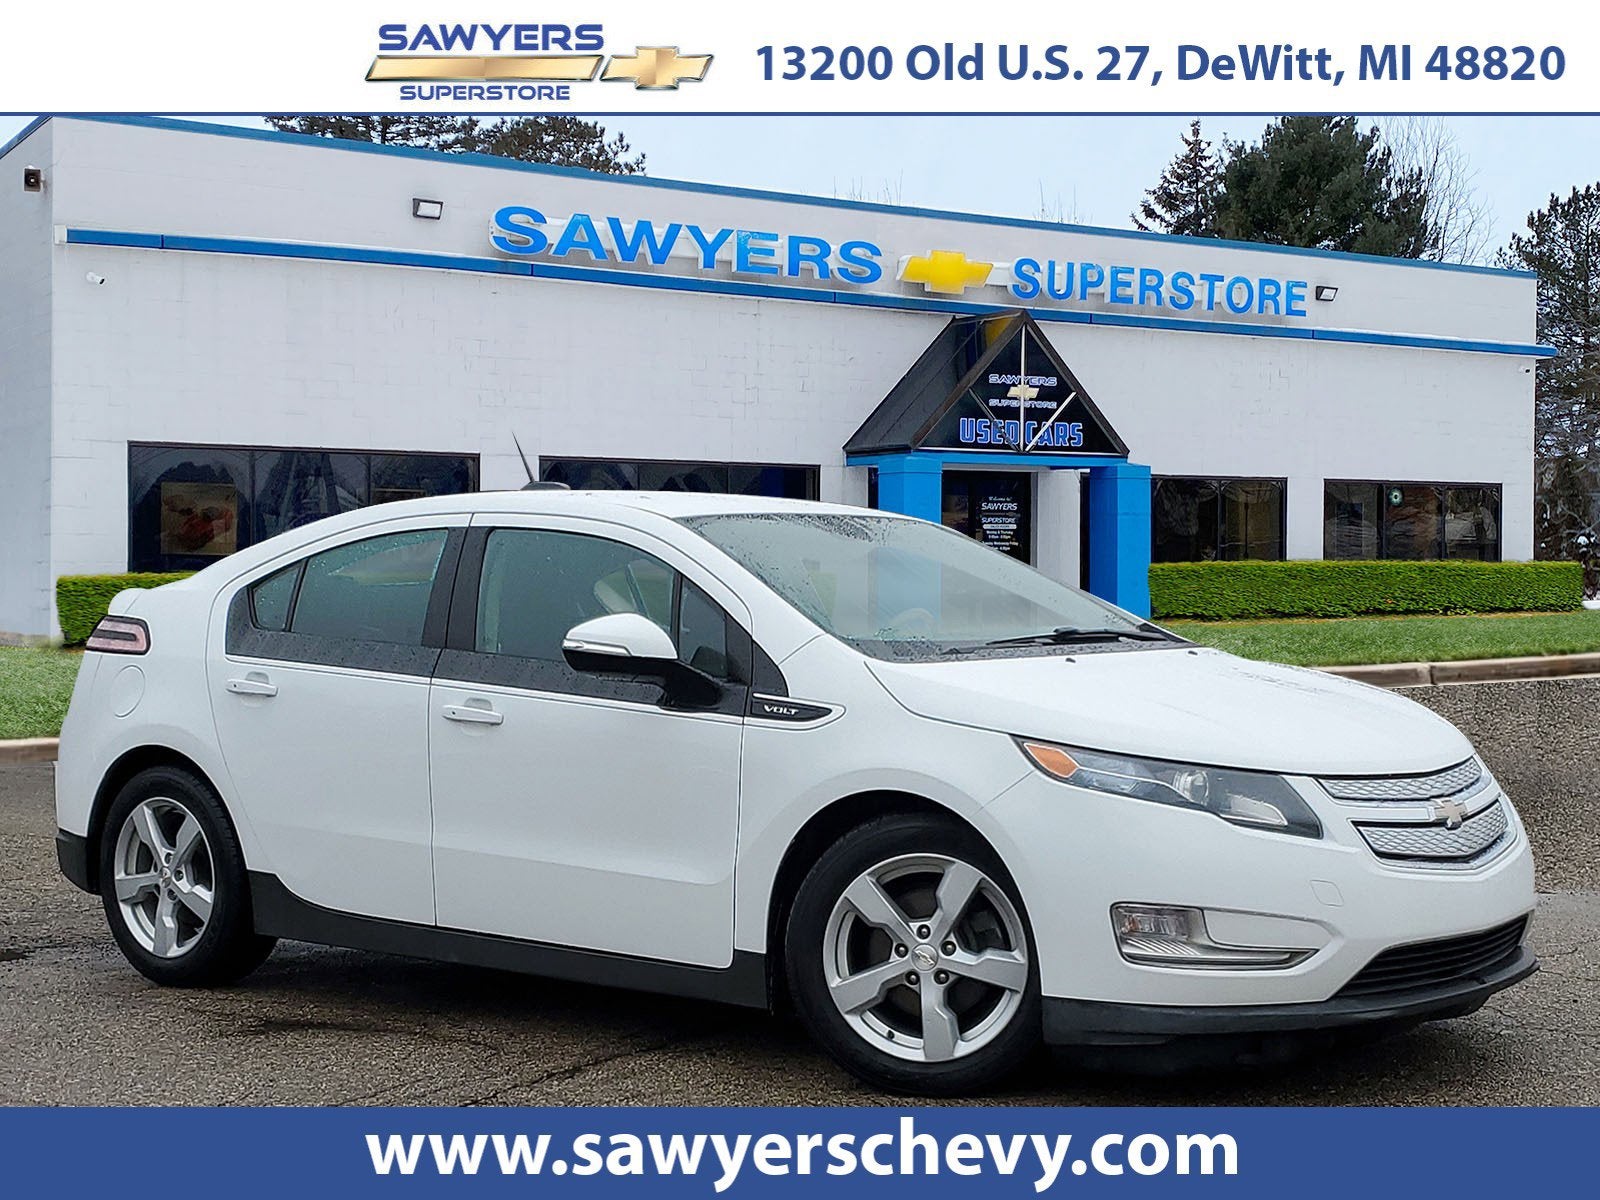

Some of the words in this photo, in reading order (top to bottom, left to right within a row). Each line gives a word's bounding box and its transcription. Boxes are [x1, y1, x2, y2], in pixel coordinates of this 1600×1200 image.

[490, 206, 883, 285] SAWYERS
[1011, 257, 1308, 317] SUPERSTORE
[989, 374, 1057, 387] SAWYERS
[960, 418, 1020, 444] USED
[1025, 421, 1083, 446] CARS
[981, 502, 1018, 511] SAWYERS
[764, 704, 799, 715] VOLT
